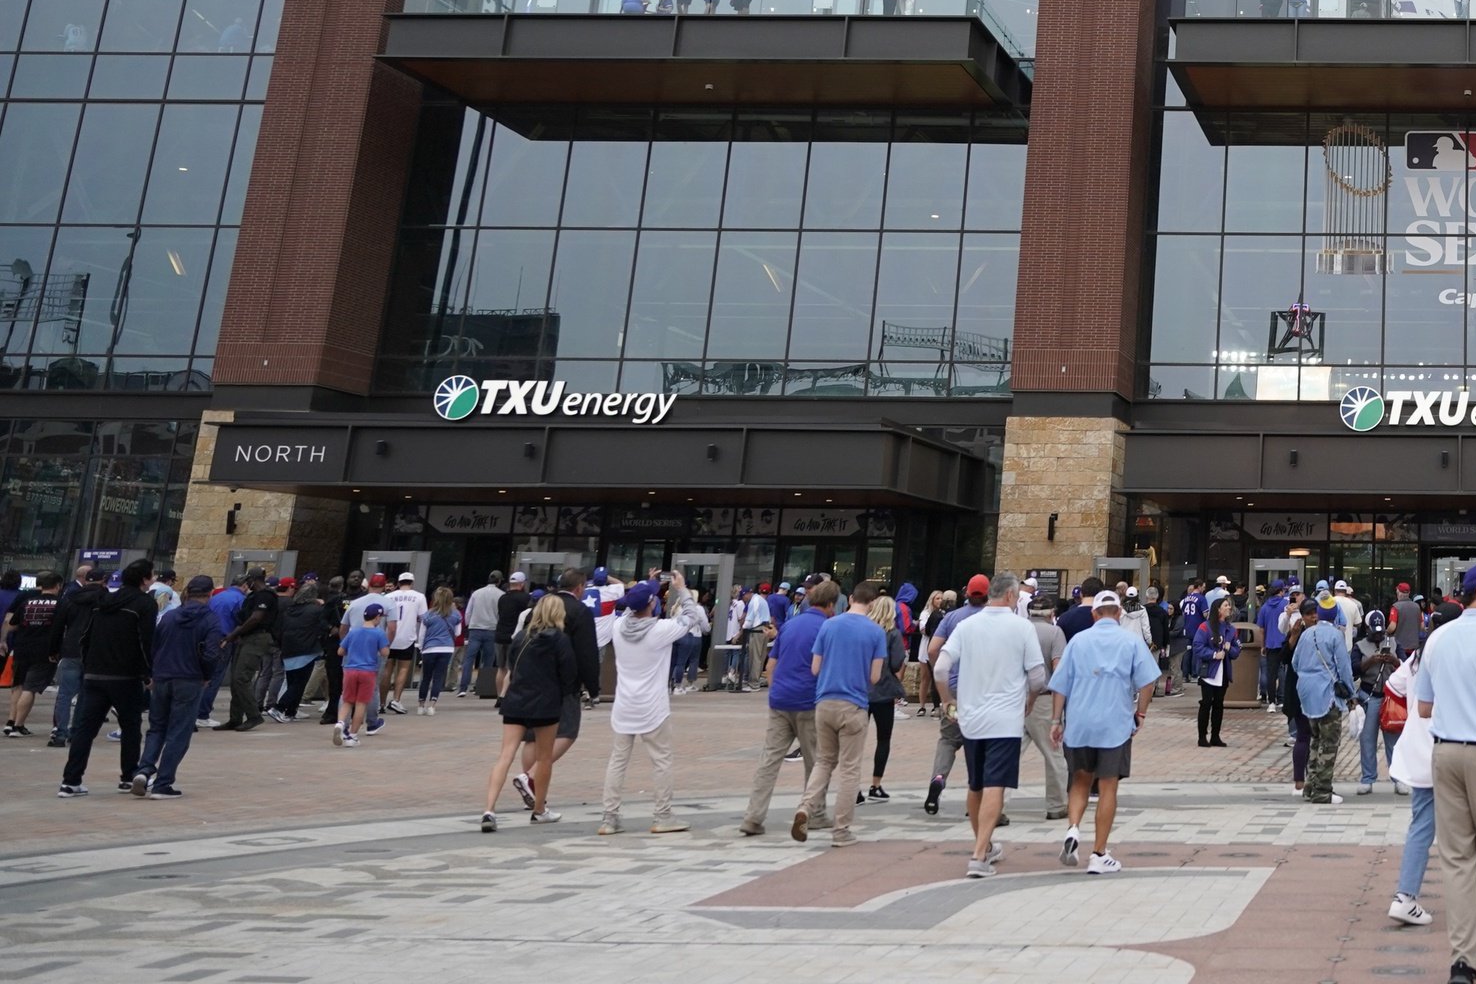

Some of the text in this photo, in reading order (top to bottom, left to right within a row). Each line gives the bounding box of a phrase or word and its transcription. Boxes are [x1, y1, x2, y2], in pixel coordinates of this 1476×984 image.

[479, 379, 678, 424] TXU energy
[1385, 390, 1471, 426] TXU
[233, 444, 327, 464] NORTH
[444, 515, 457, 528] GO
[621, 519, 682, 528] WORLD SERIES
[793, 517, 806, 531] GO
[1260, 522, 1273, 535] GO
[1287, 521, 1305, 537] TAKE
[1305, 522, 1316, 536] IT
[1437, 526, 1469, 534] WORLD
[1184, 602, 1196, 616] 49
